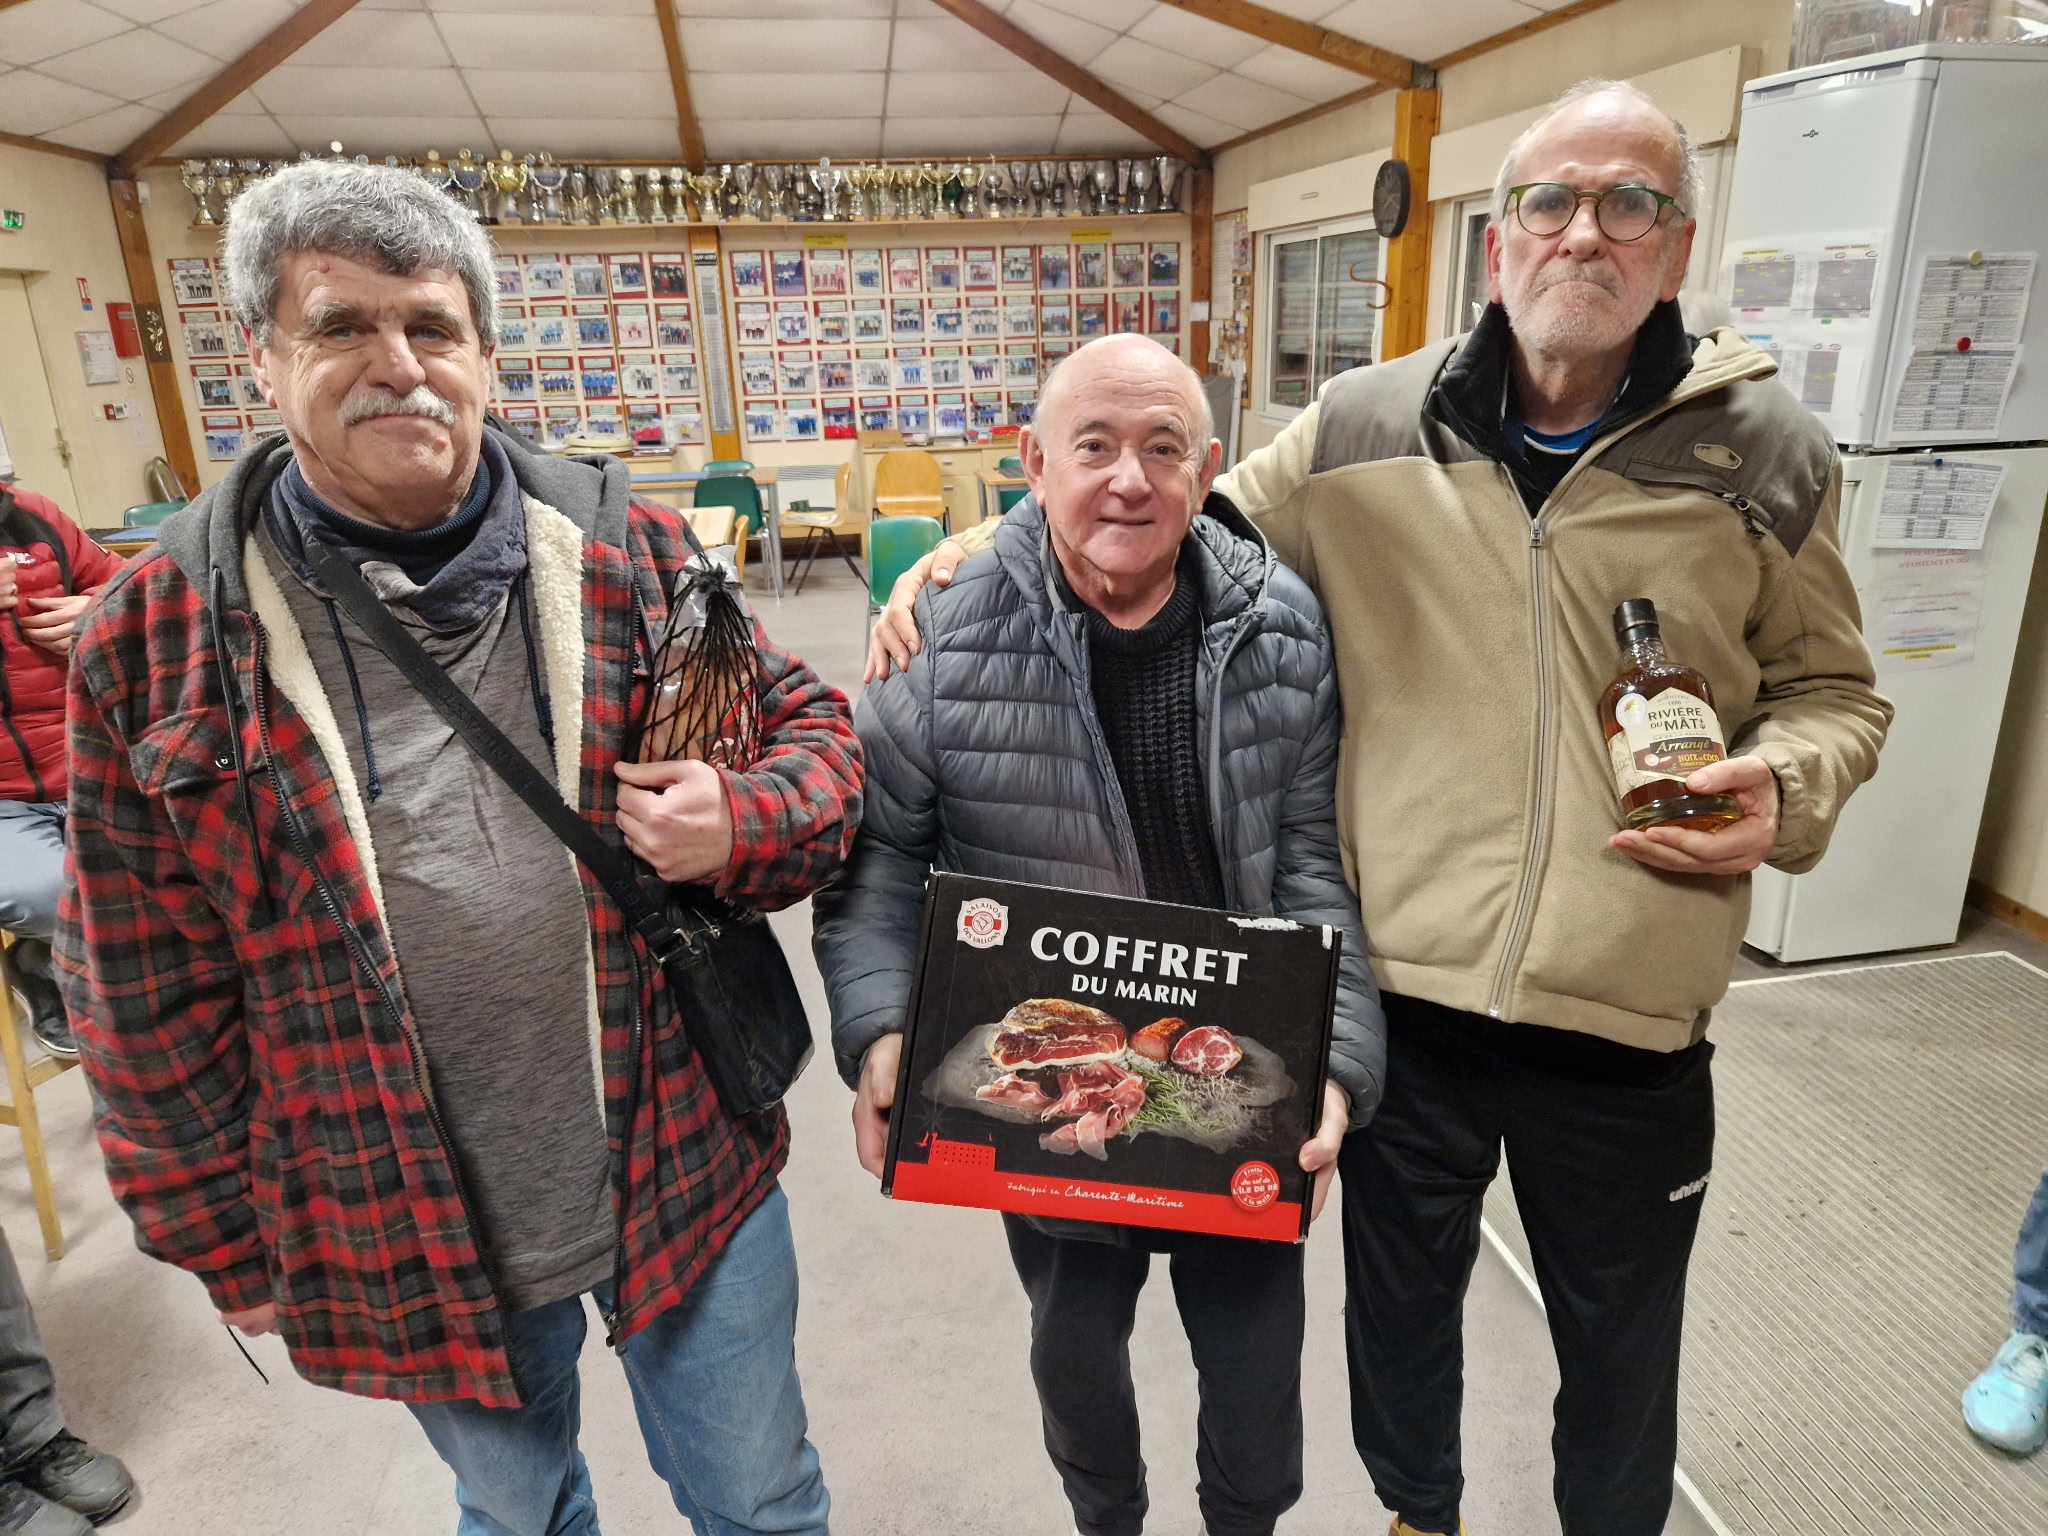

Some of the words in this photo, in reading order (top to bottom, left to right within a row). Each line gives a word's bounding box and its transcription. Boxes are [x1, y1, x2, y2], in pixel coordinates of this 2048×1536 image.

[1648, 705, 1703, 721] RIVIÈRE
[1650, 721, 1663, 729] DU
[1664, 716, 1698, 731] MÂT
[1655, 739, 1710, 754] Arrangé
[1678, 754, 1698, 763] NOIX
[1703, 753, 1720, 762] COCO
[966, 902, 1003, 918] SALAISON
[963, 927, 972, 939] DES
[972, 931, 1001, 944] VALLONS
[1030, 926, 1248, 986] COFFRET
[1072, 974, 1108, 995] DU
[1114, 983, 1198, 1008] MARIN
[1007, 1181, 1046, 1196] Fabriqué
[1064, 1184, 1185, 1208] Charente-Maritime
[1253, 1185, 1265, 1193] DE
[1267, 1182, 1279, 1192] RÉ
[1256, 1193, 1271, 1205] main
